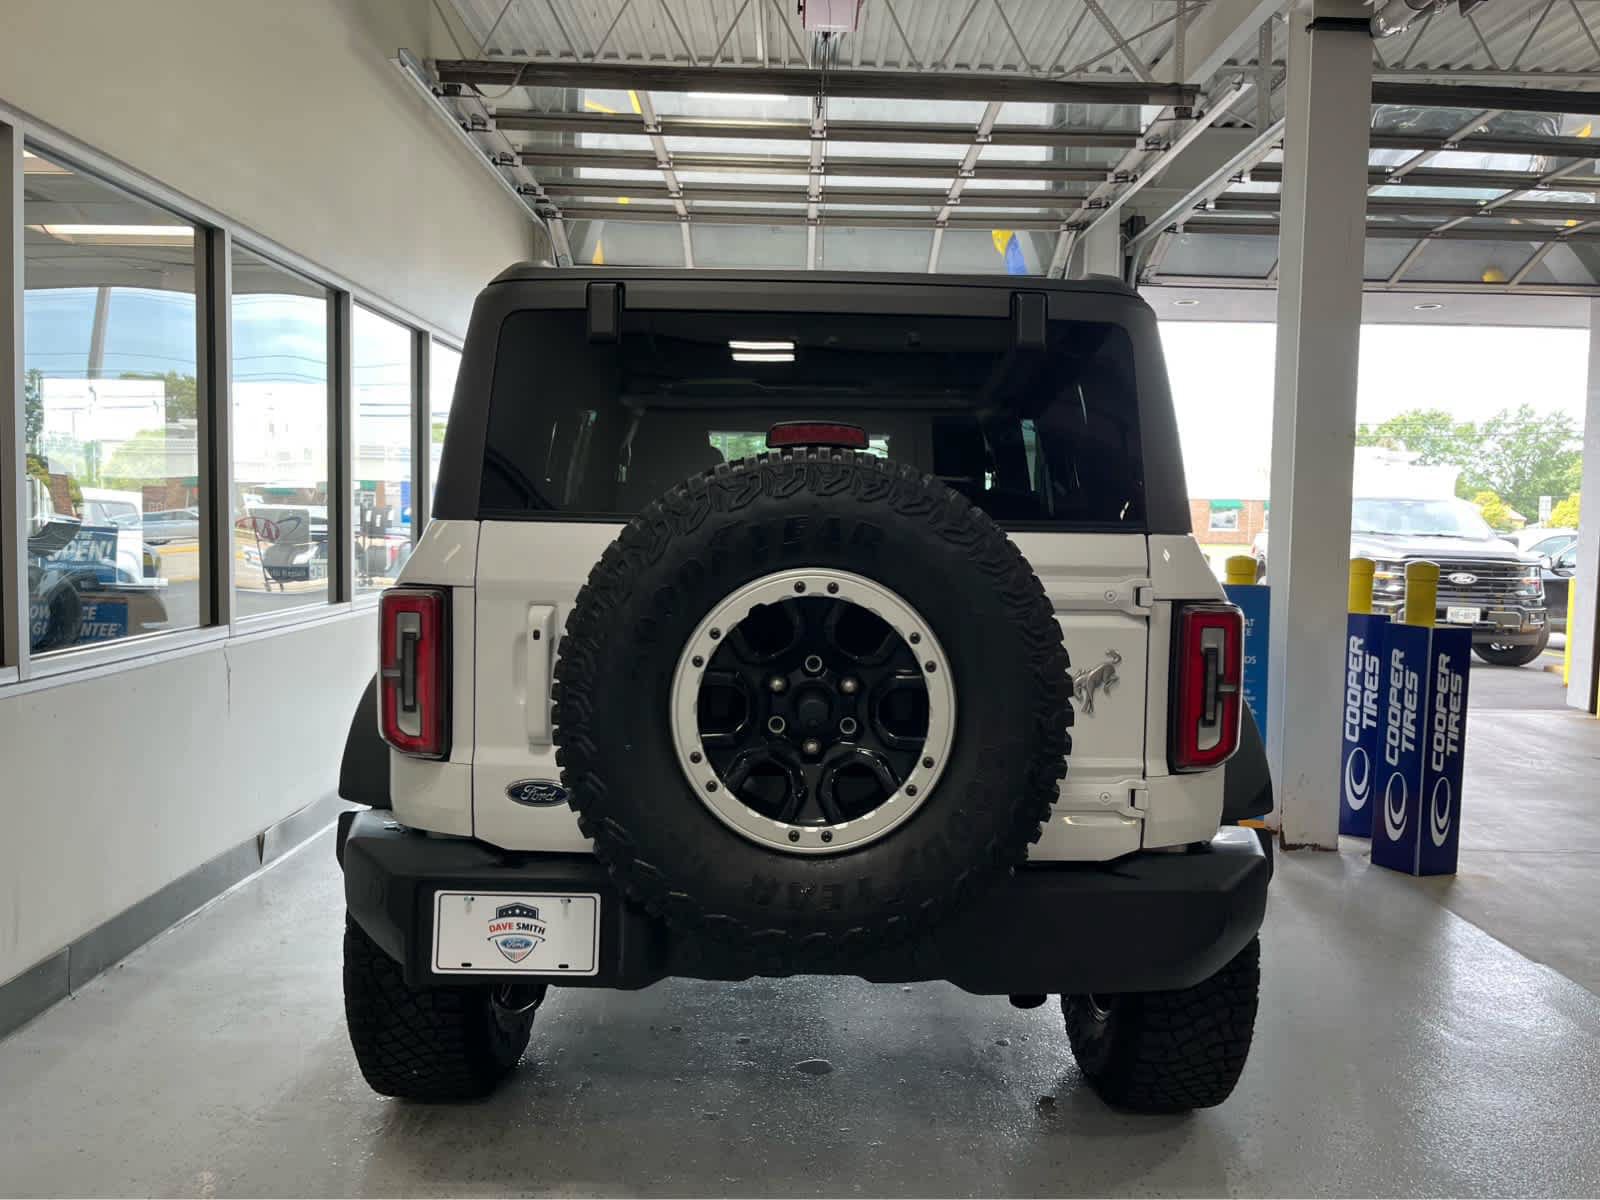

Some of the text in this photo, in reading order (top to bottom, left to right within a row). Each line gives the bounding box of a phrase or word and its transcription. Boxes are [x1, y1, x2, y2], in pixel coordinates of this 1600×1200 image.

[32, 622, 119, 637] GUNTEE
[1345, 635, 1364, 743] COOPER
[1362, 655, 1380, 730] TIRES
[1385, 648, 1405, 767] COOPER
[1402, 671, 1419, 753] TIRES
[1432, 652, 1451, 772] COOPER
[1446, 674, 1463, 756] TIRES
[521, 785, 557, 800] Ford
[489, 922, 546, 935] DAVE SMITH
